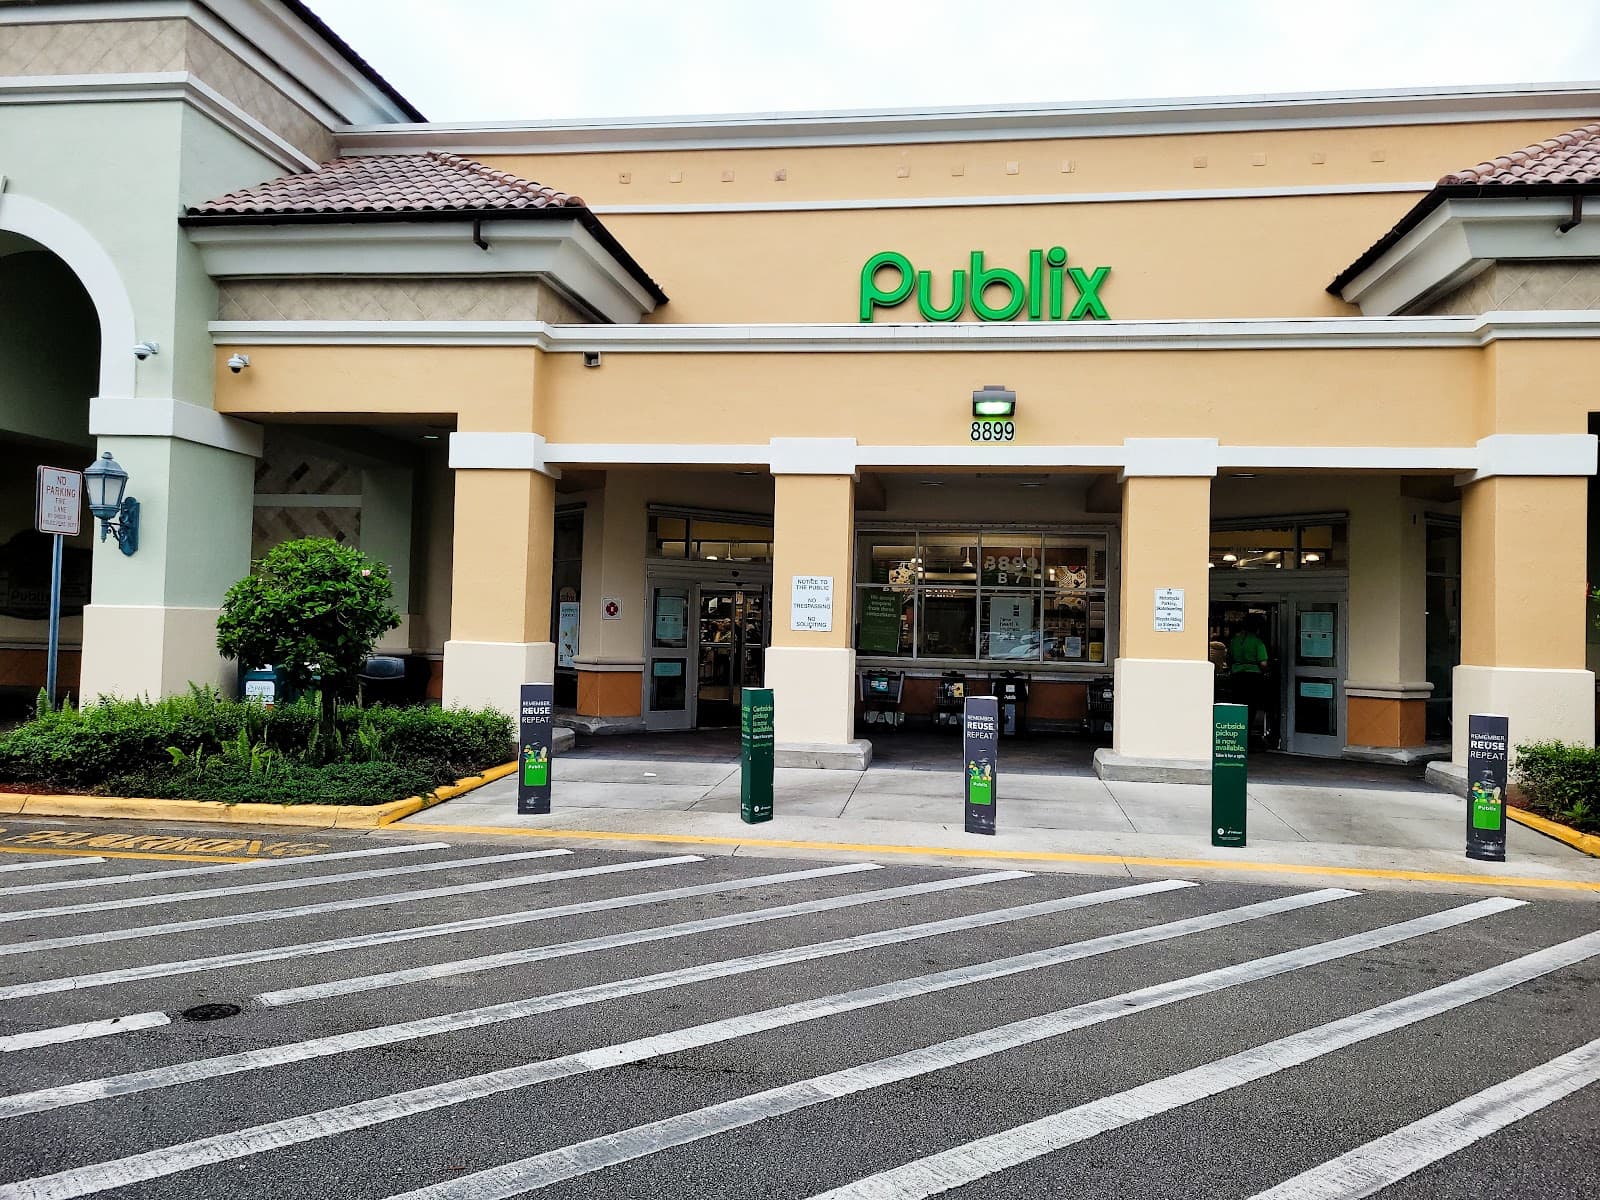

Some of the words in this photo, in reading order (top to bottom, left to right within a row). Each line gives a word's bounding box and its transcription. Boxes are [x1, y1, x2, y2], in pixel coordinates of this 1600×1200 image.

[859, 246, 1112, 323] Publix
[970, 421, 1015, 441] 8899
[57, 475, 67, 486] NO
[46, 485, 76, 498] PARKING
[522, 707, 551, 715] REUSE
[967, 721, 994, 731] REUSE
[1215, 722, 1246, 730] Curbside
[1215, 730, 1239, 739] pickup
[1470, 740, 1505, 751] REUSE
[1470, 751, 1506, 761] REPEAT.
[1477, 804, 1497, 812] Publix
